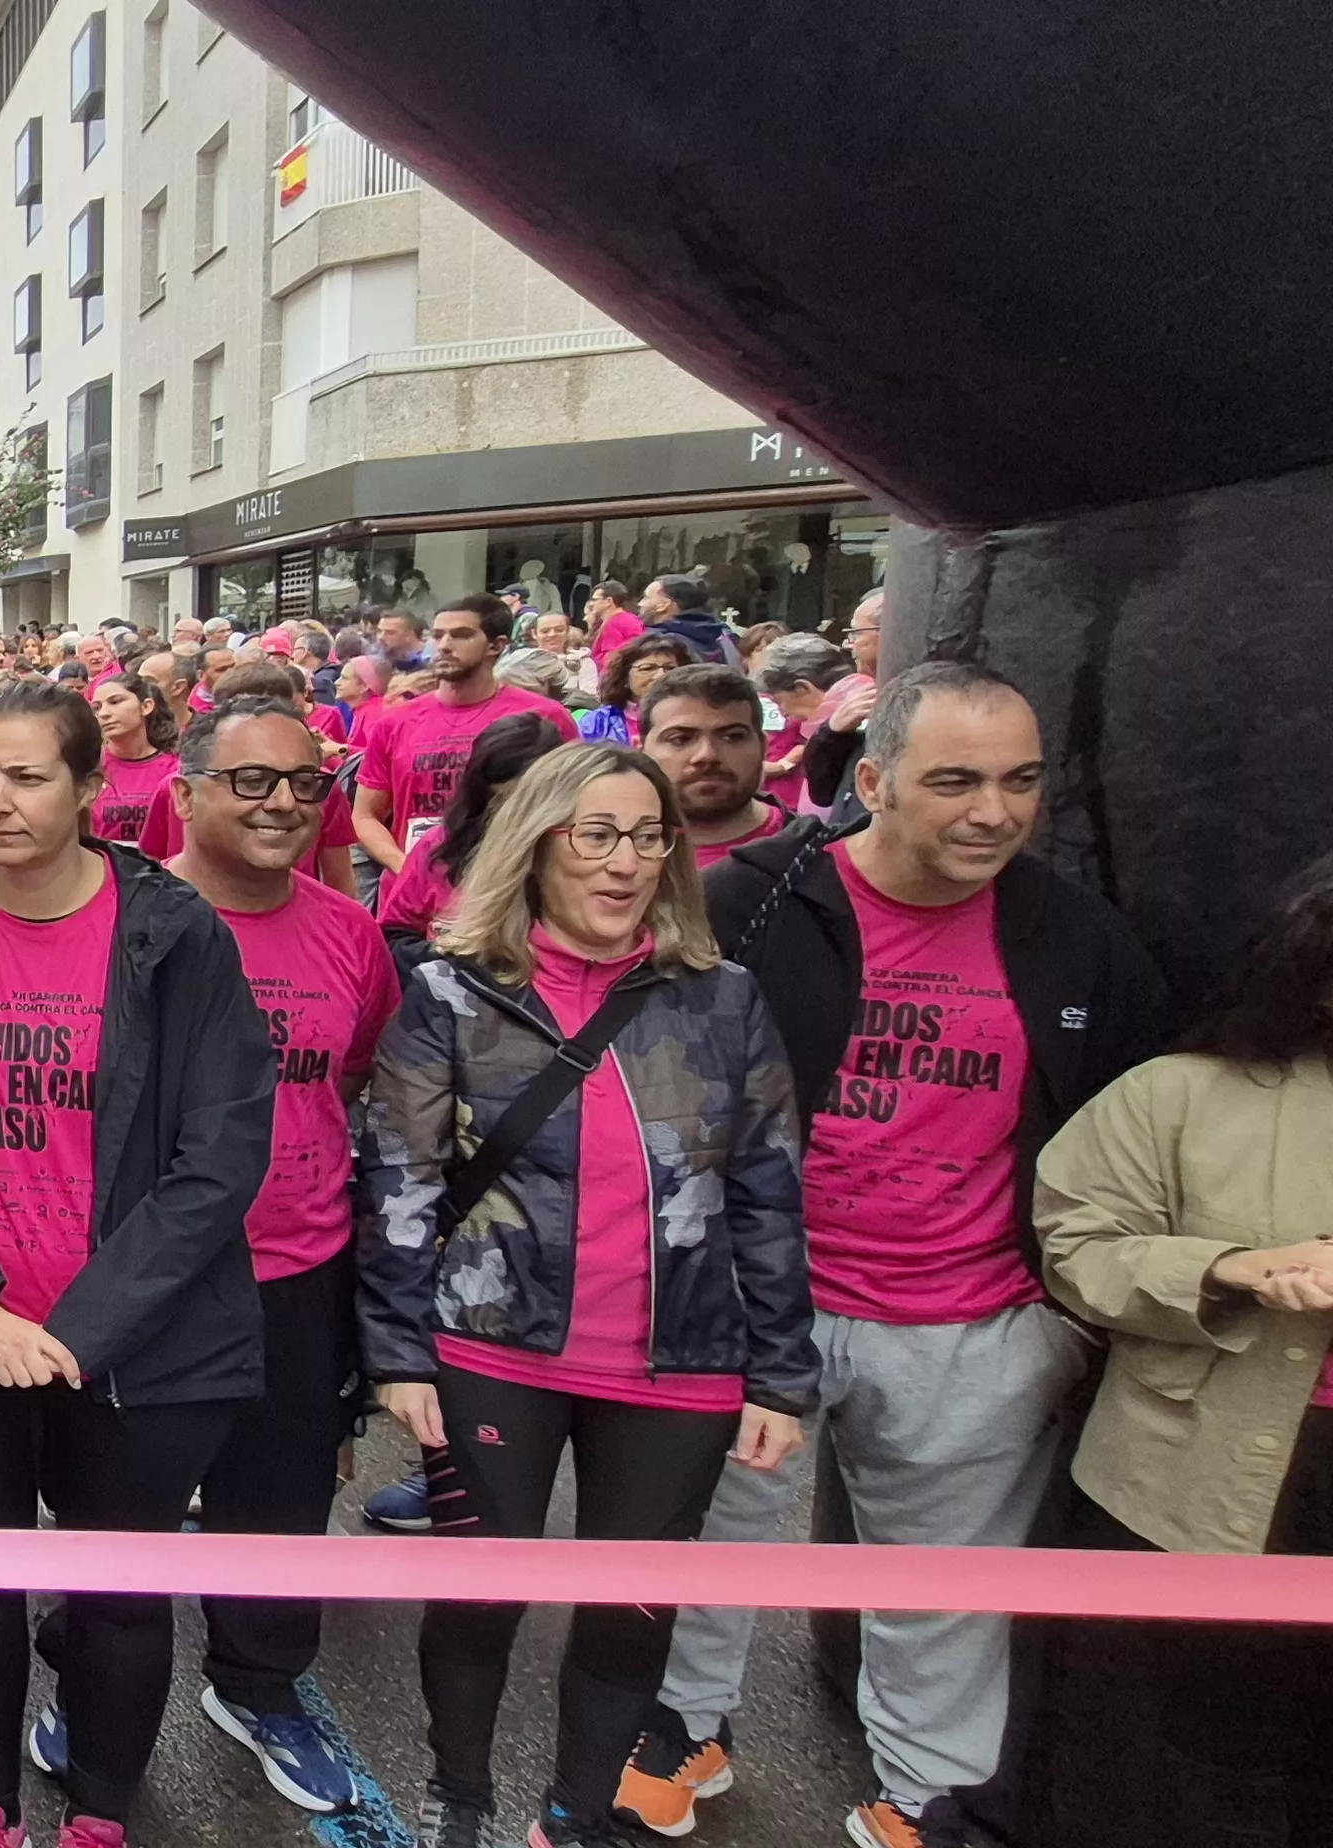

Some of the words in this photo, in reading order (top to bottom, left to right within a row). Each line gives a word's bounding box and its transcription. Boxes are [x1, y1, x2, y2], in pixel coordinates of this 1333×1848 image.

[235, 490, 282, 526] MIRATE
[127, 529, 180, 543] MIRATE
[892, 970, 960, 983] CARRERA
[253, 989, 274, 998] TRA
[873, 980, 931, 993] CONTRA
[936, 984, 952, 994] EL
[64, 1006, 78, 1015] EL
[856, 1039, 904, 1080] EN
[909, 1045, 1002, 1091] CADA
[8, 1065, 45, 1106] EN
[828, 1075, 898, 1123] ASO
